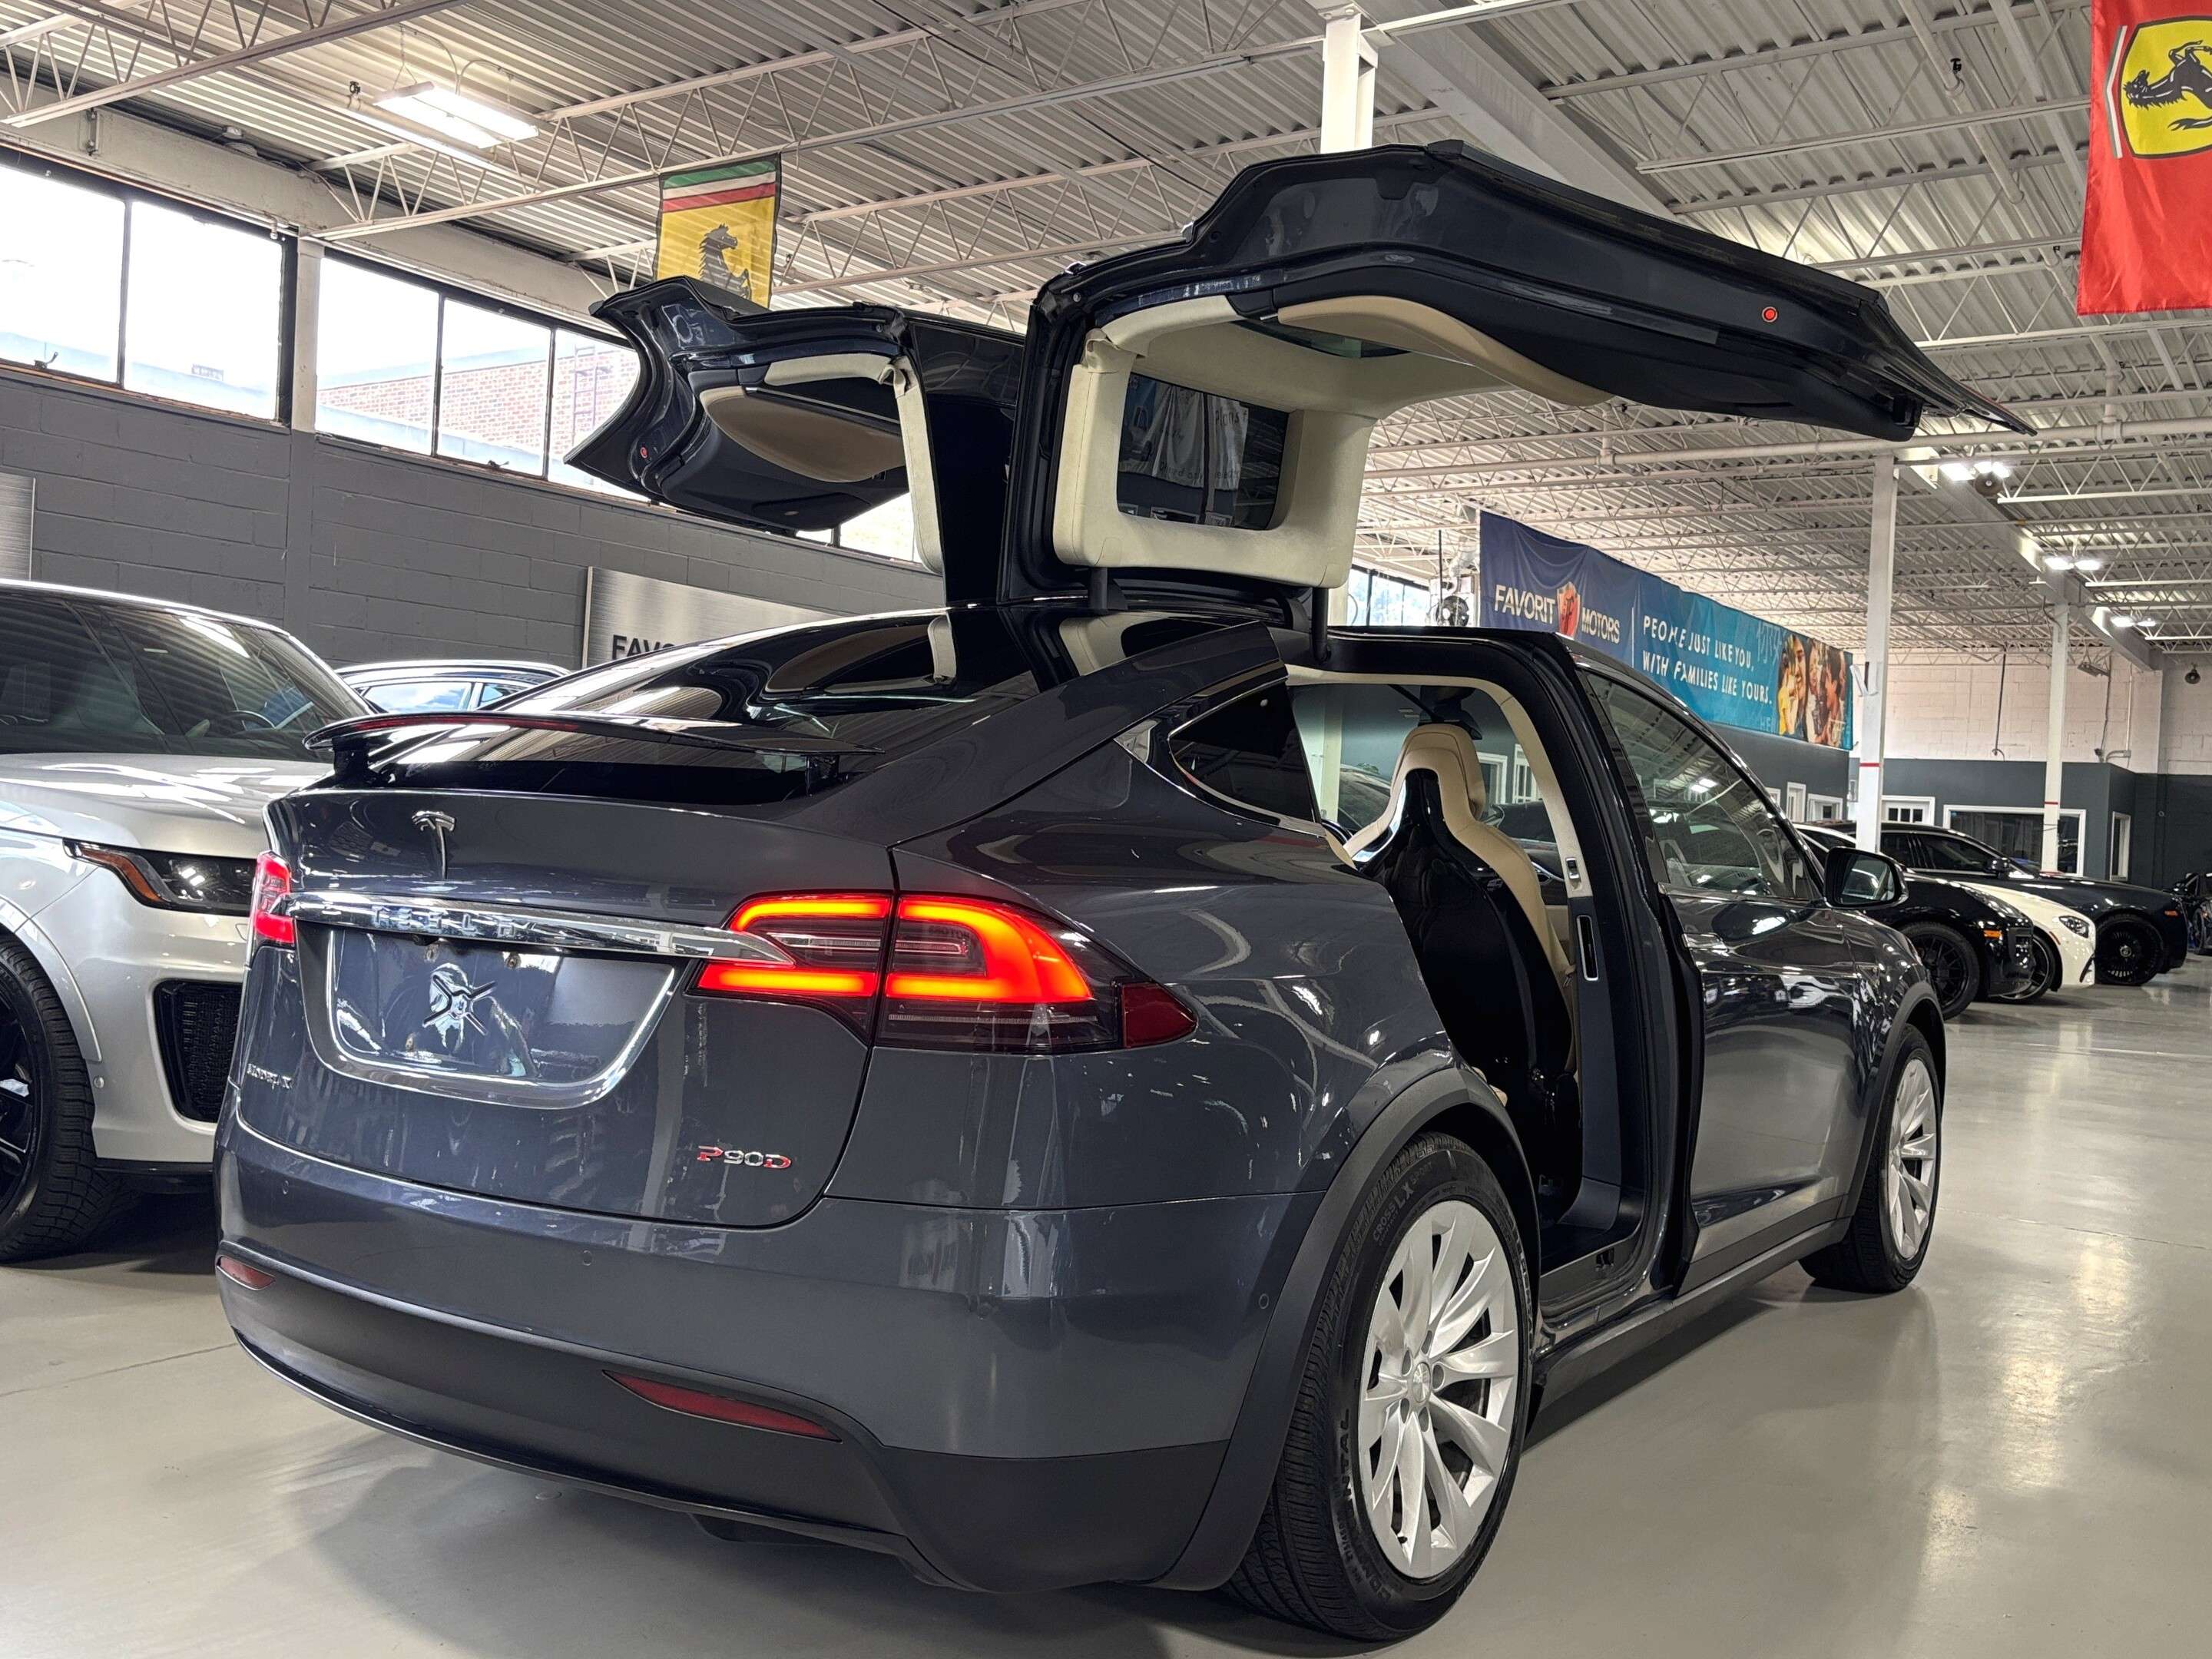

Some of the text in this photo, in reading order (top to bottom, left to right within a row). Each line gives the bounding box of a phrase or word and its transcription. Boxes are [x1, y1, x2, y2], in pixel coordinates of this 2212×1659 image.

[1495, 584, 1620, 644] FAVORIT MOTORS
[612, 634, 675, 661] FAV
[1688, 632, 1710, 656] JUST
[1714, 639, 1733, 663] LIKE
[1734, 647, 1754, 672] YOU,
[1642, 650, 1772, 705] WITH FAMILIES LIKE YOURS.
[370, 904, 515, 939] TESLA
[697, 1145, 793, 1170] P90D
[1373, 1202, 1396, 1242] CROSS
[1393, 1181, 1415, 1209] LX
